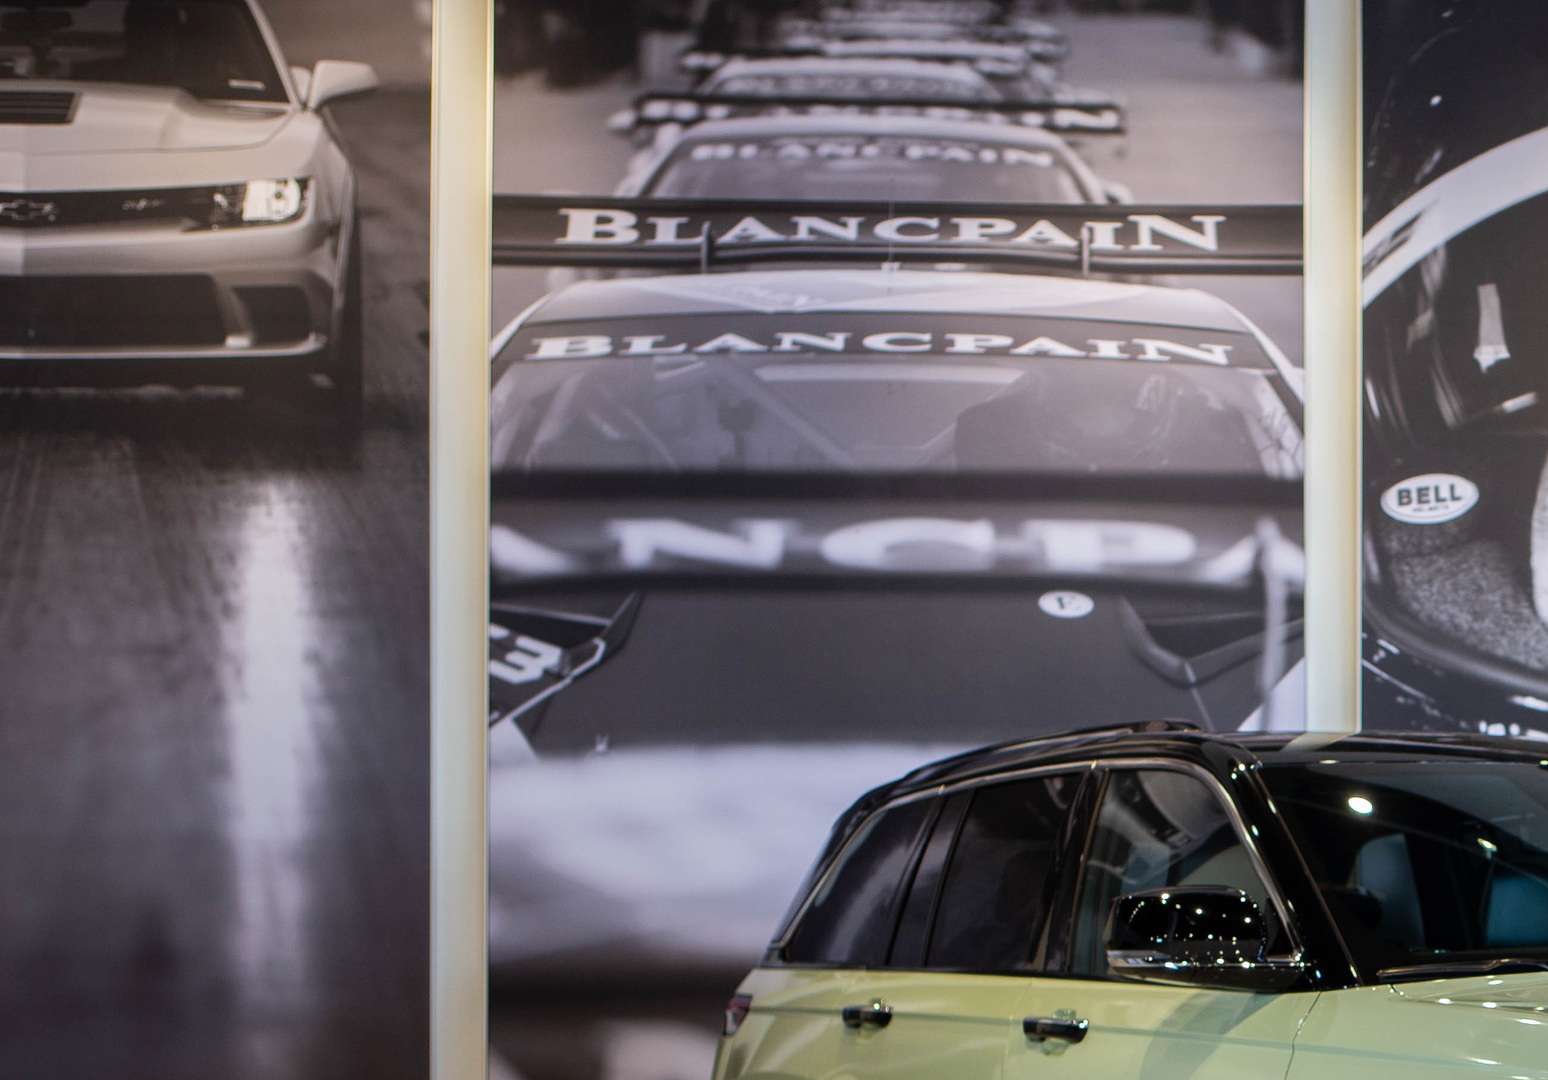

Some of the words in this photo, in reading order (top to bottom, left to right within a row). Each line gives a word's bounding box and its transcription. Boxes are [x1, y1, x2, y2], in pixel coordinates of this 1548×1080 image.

[555, 208, 1228, 252] BLANCPAIN
[526, 331, 1234, 368] BLANCPAIN
[1398, 482, 1463, 506] BELL
